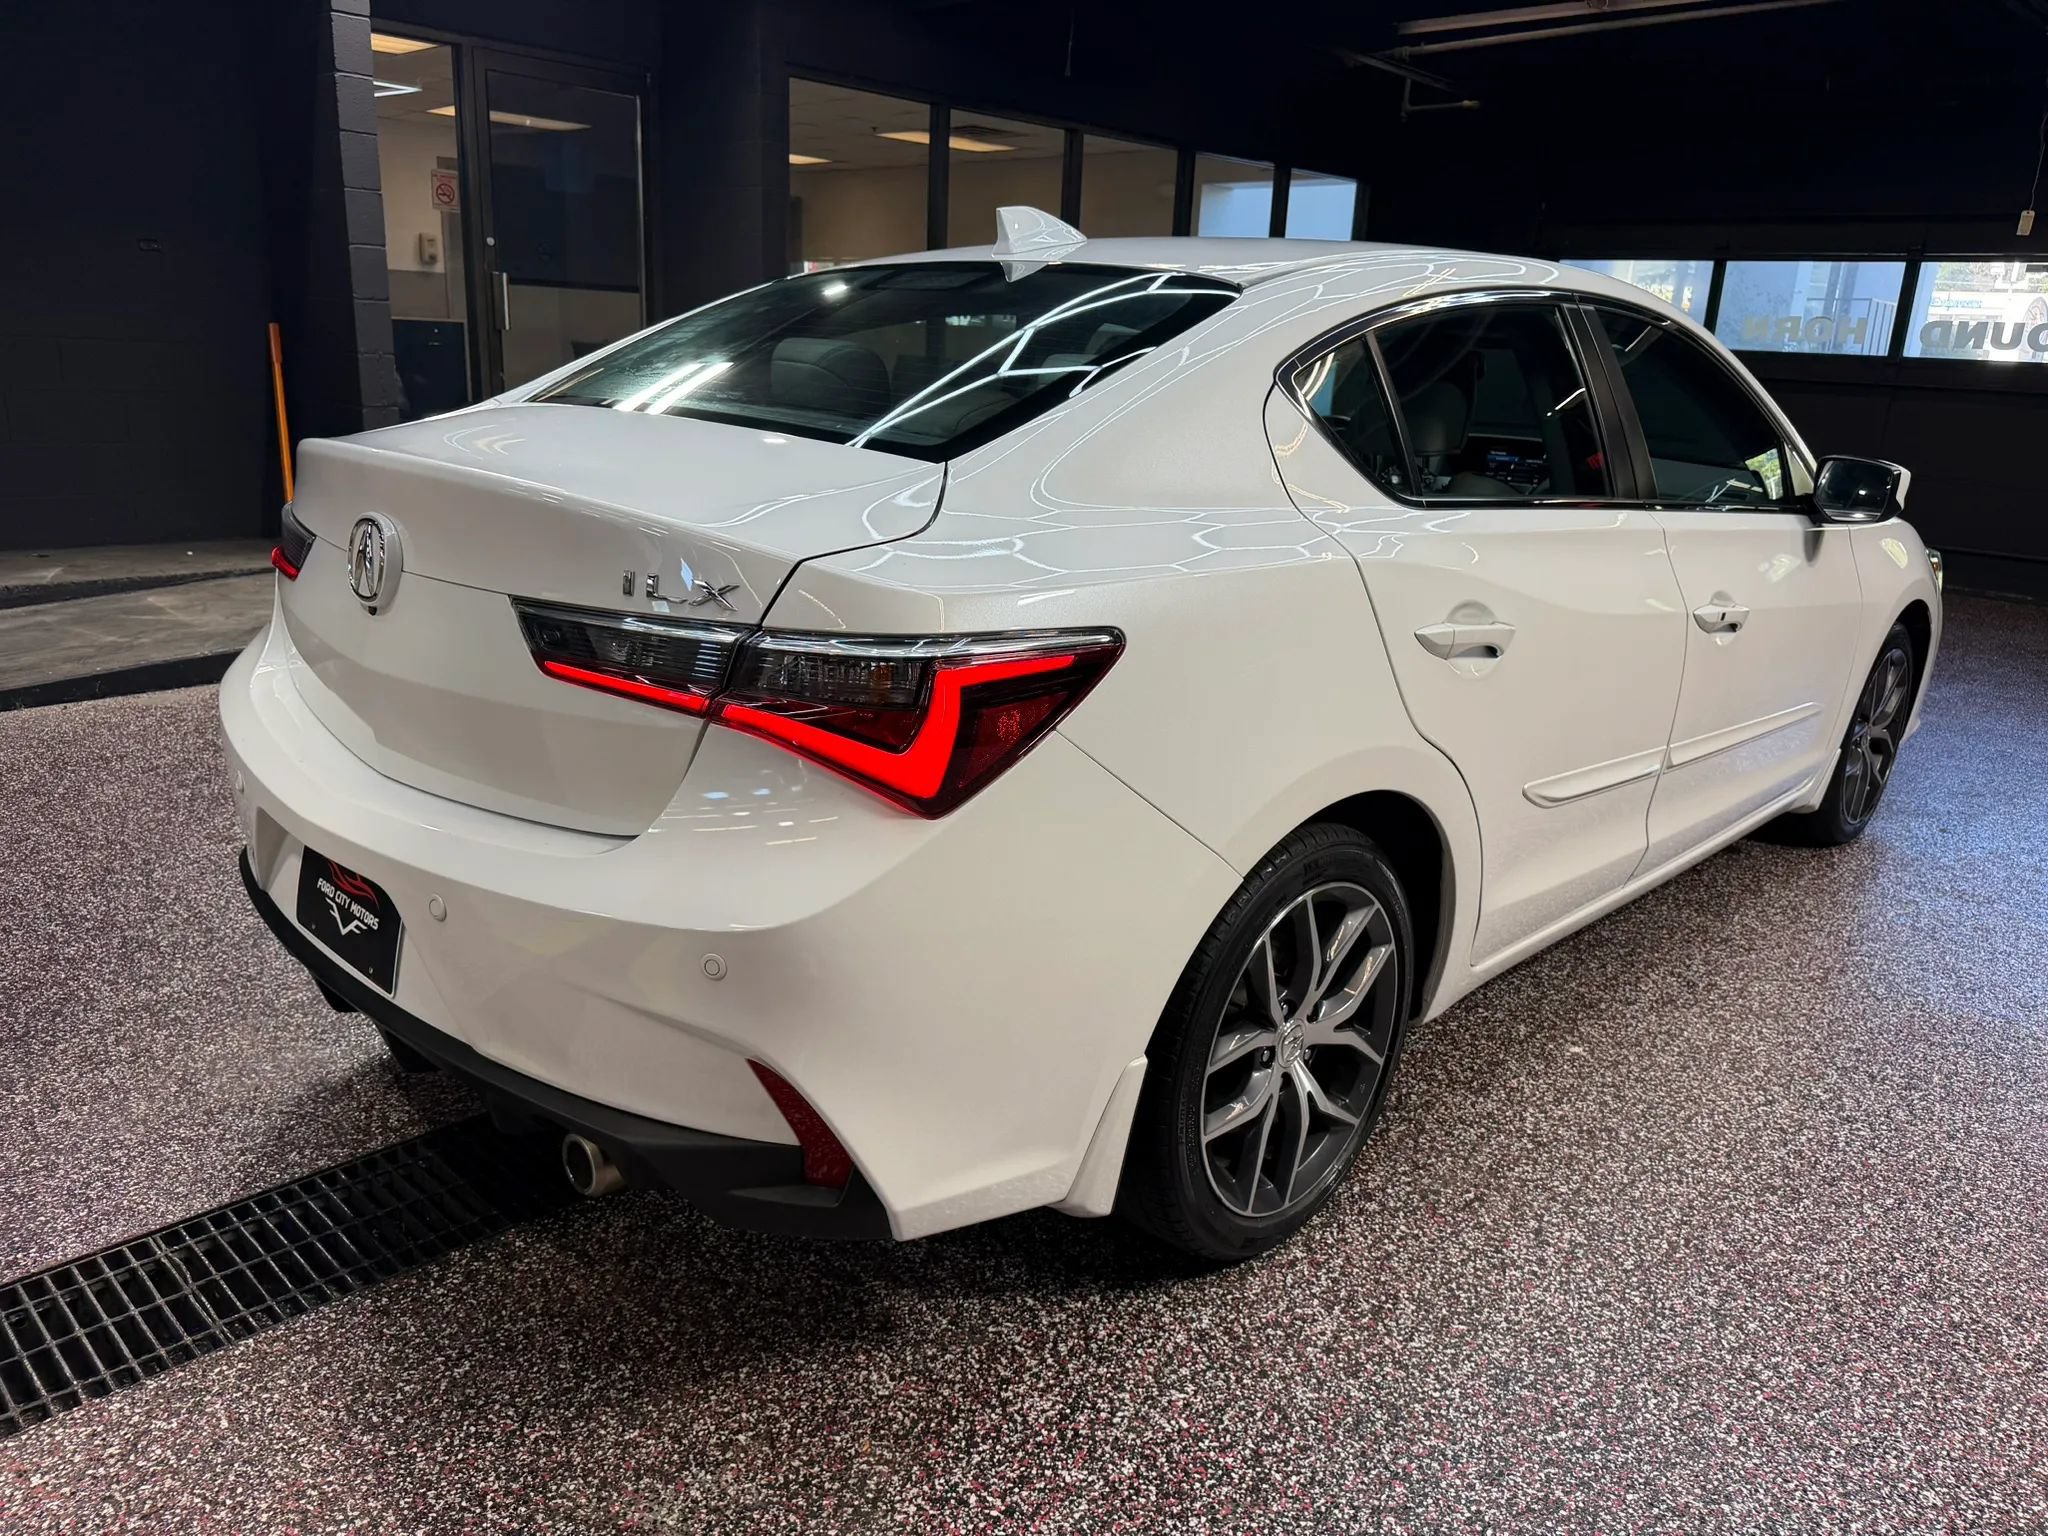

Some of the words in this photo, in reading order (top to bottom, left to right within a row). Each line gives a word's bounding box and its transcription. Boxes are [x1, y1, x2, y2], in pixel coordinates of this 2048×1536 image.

[623, 570, 740, 611] ILX
[316, 877, 334, 898] FORD
[335, 890, 350, 909] CITY
[350, 901, 380, 930] MOTORS
